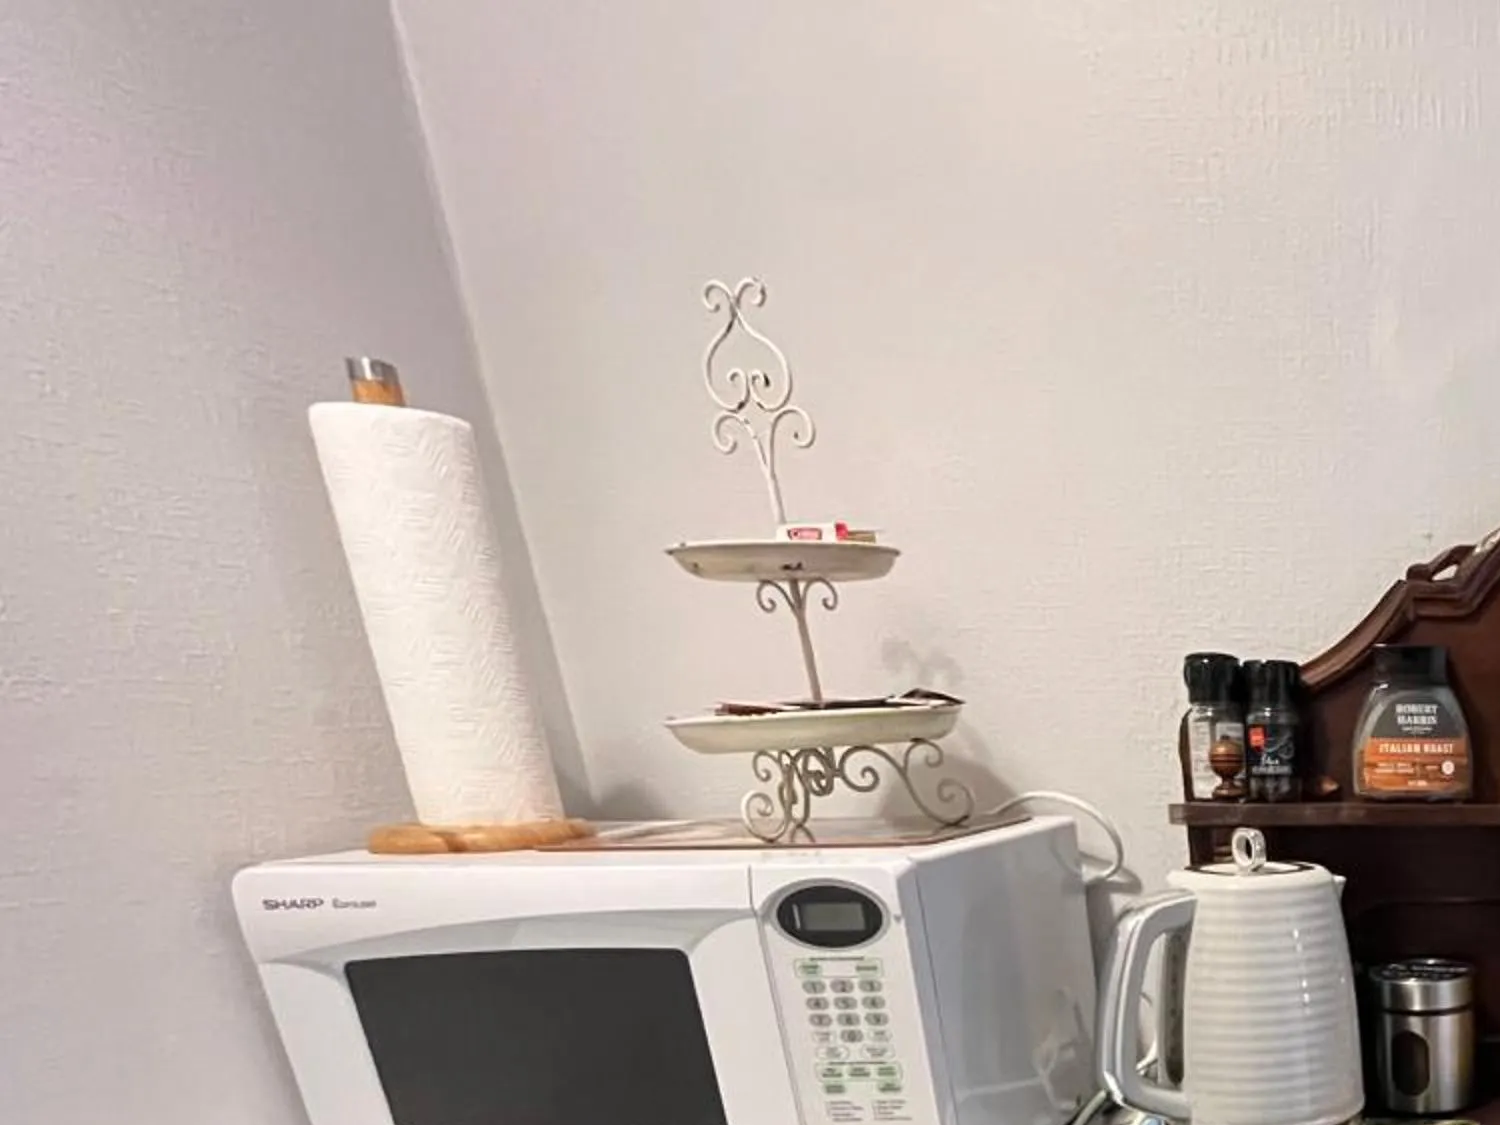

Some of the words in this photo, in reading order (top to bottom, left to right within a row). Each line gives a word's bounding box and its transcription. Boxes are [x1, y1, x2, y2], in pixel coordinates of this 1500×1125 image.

[1395, 703, 1438, 714] ROBERT
[1397, 715, 1438, 725] HARRIS
[1379, 743, 1421, 753] ITALIAN
[1423, 743, 1454, 754] ROAST
[262, 898, 324, 911] SHARP
